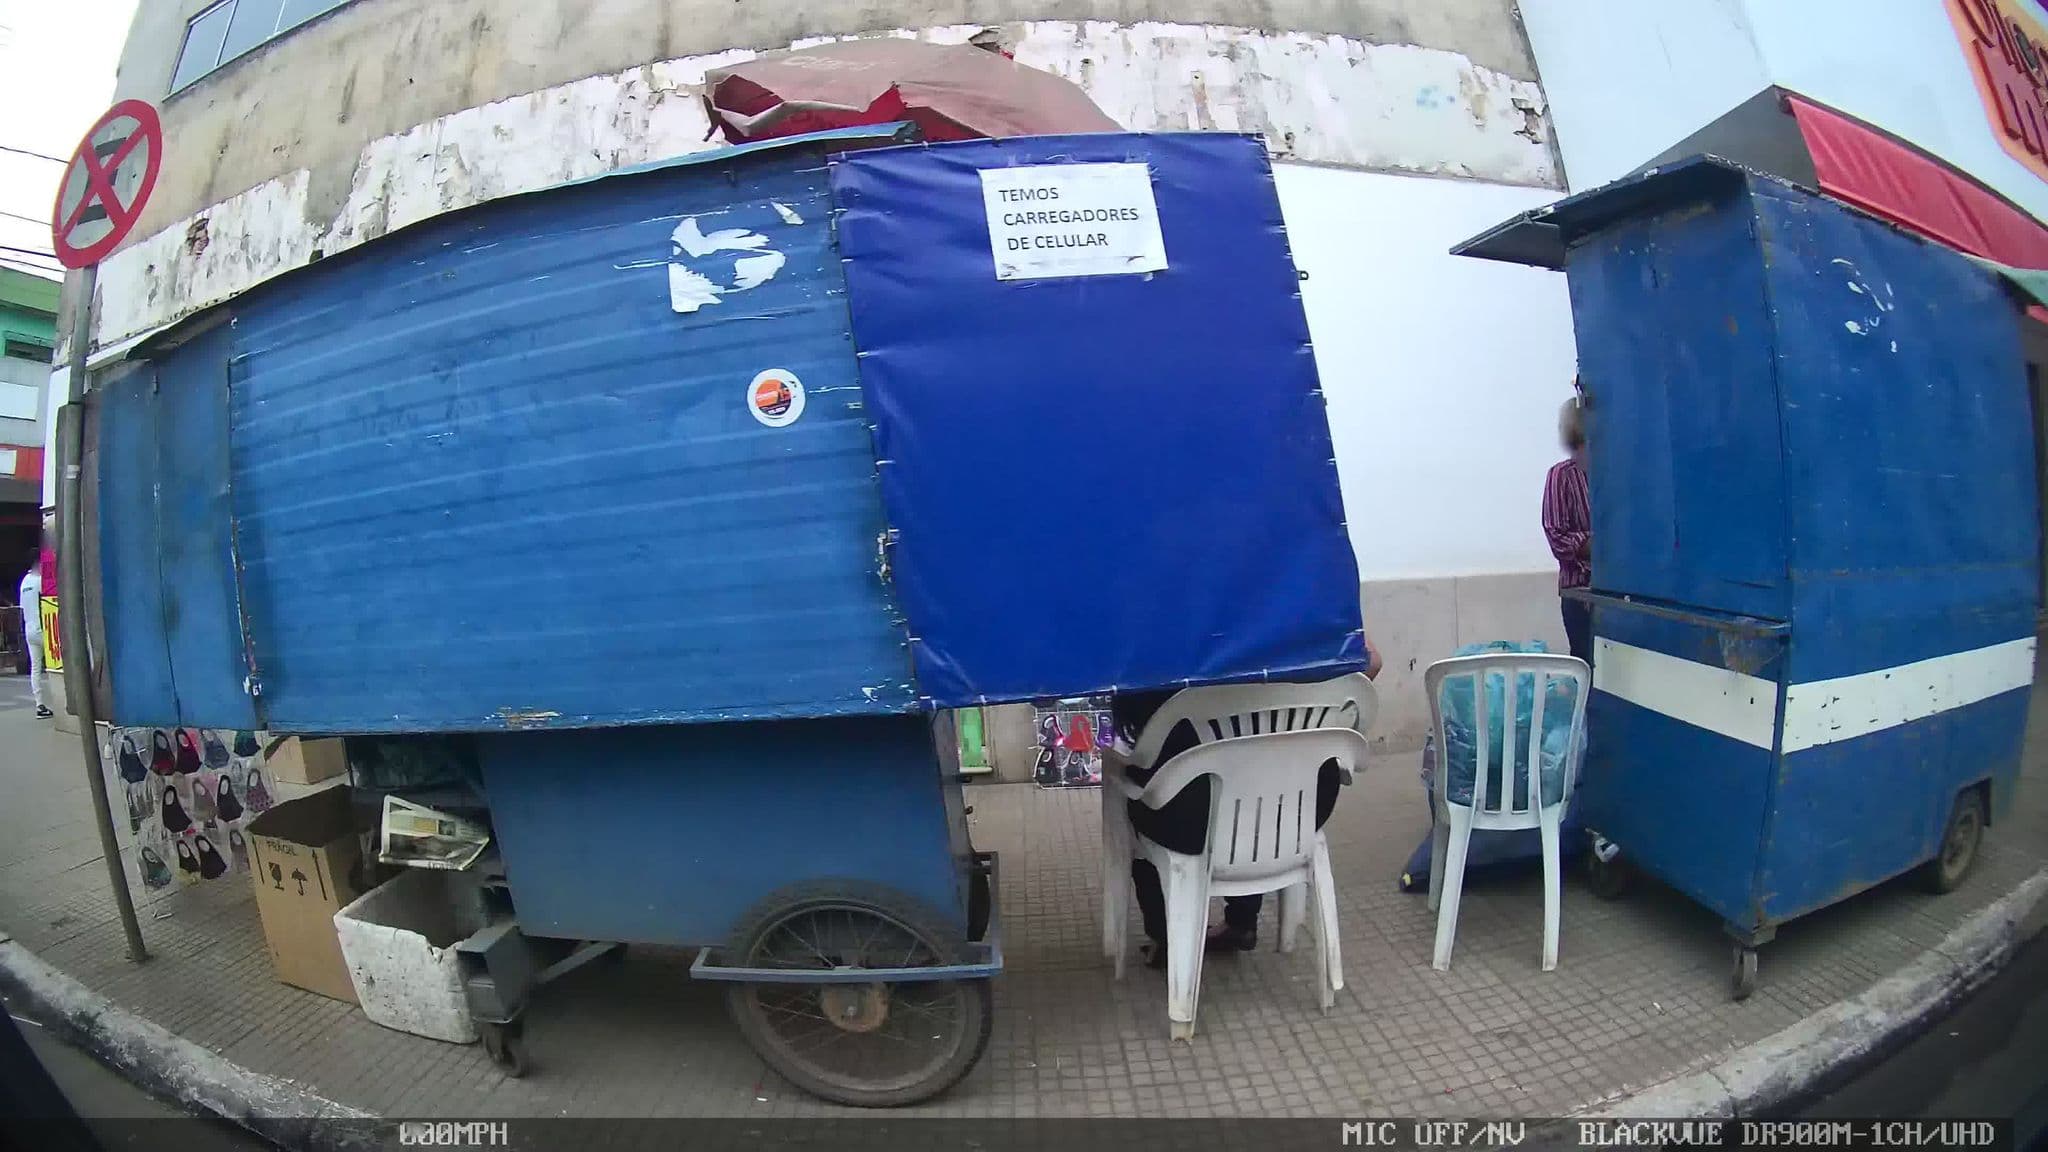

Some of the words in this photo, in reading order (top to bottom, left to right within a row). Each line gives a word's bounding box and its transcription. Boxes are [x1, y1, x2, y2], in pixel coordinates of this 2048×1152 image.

[998, 187, 1059, 202] TEMOS
[1003, 208, 1139, 226] CARREGADORES
[1007, 237, 1029, 251] DE
[1034, 233, 1108, 249] CELULAR
